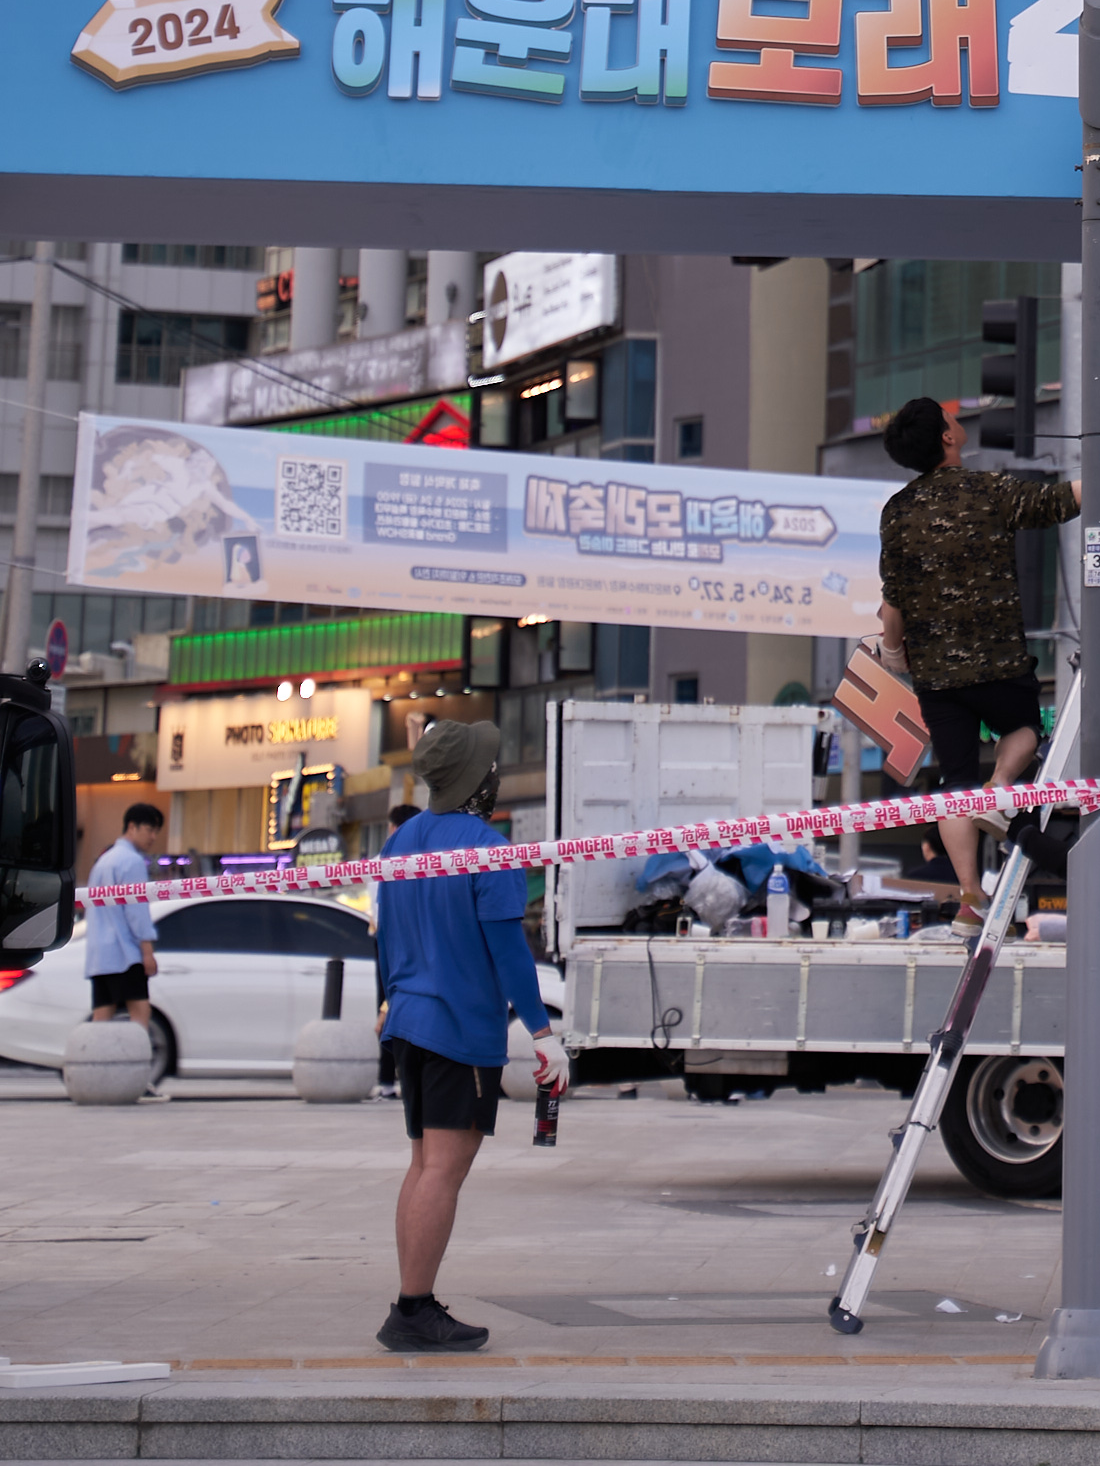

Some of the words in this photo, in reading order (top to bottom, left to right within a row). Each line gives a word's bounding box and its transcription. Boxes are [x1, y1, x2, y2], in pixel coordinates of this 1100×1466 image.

[128, 4, 240, 56] 2024
[225, 724, 264, 746] PHOTO
[88, 882, 147, 899] DANGER!
[181, 877, 208, 891] 위험
[325, 860, 382, 878] DANGER!
[415, 856, 442, 870] 위험
[488, 844, 541, 863] 안전제일
[557, 837, 614, 856] DANGER!
[646, 830, 673, 846] 위험
[718, 819, 771, 839] 안전제일
[786, 812, 842, 832] DANGER!
[874, 805, 900, 822] 위험
[945, 794, 997, 815] 안전제일
[1012, 789, 1068, 808] DANGER!
